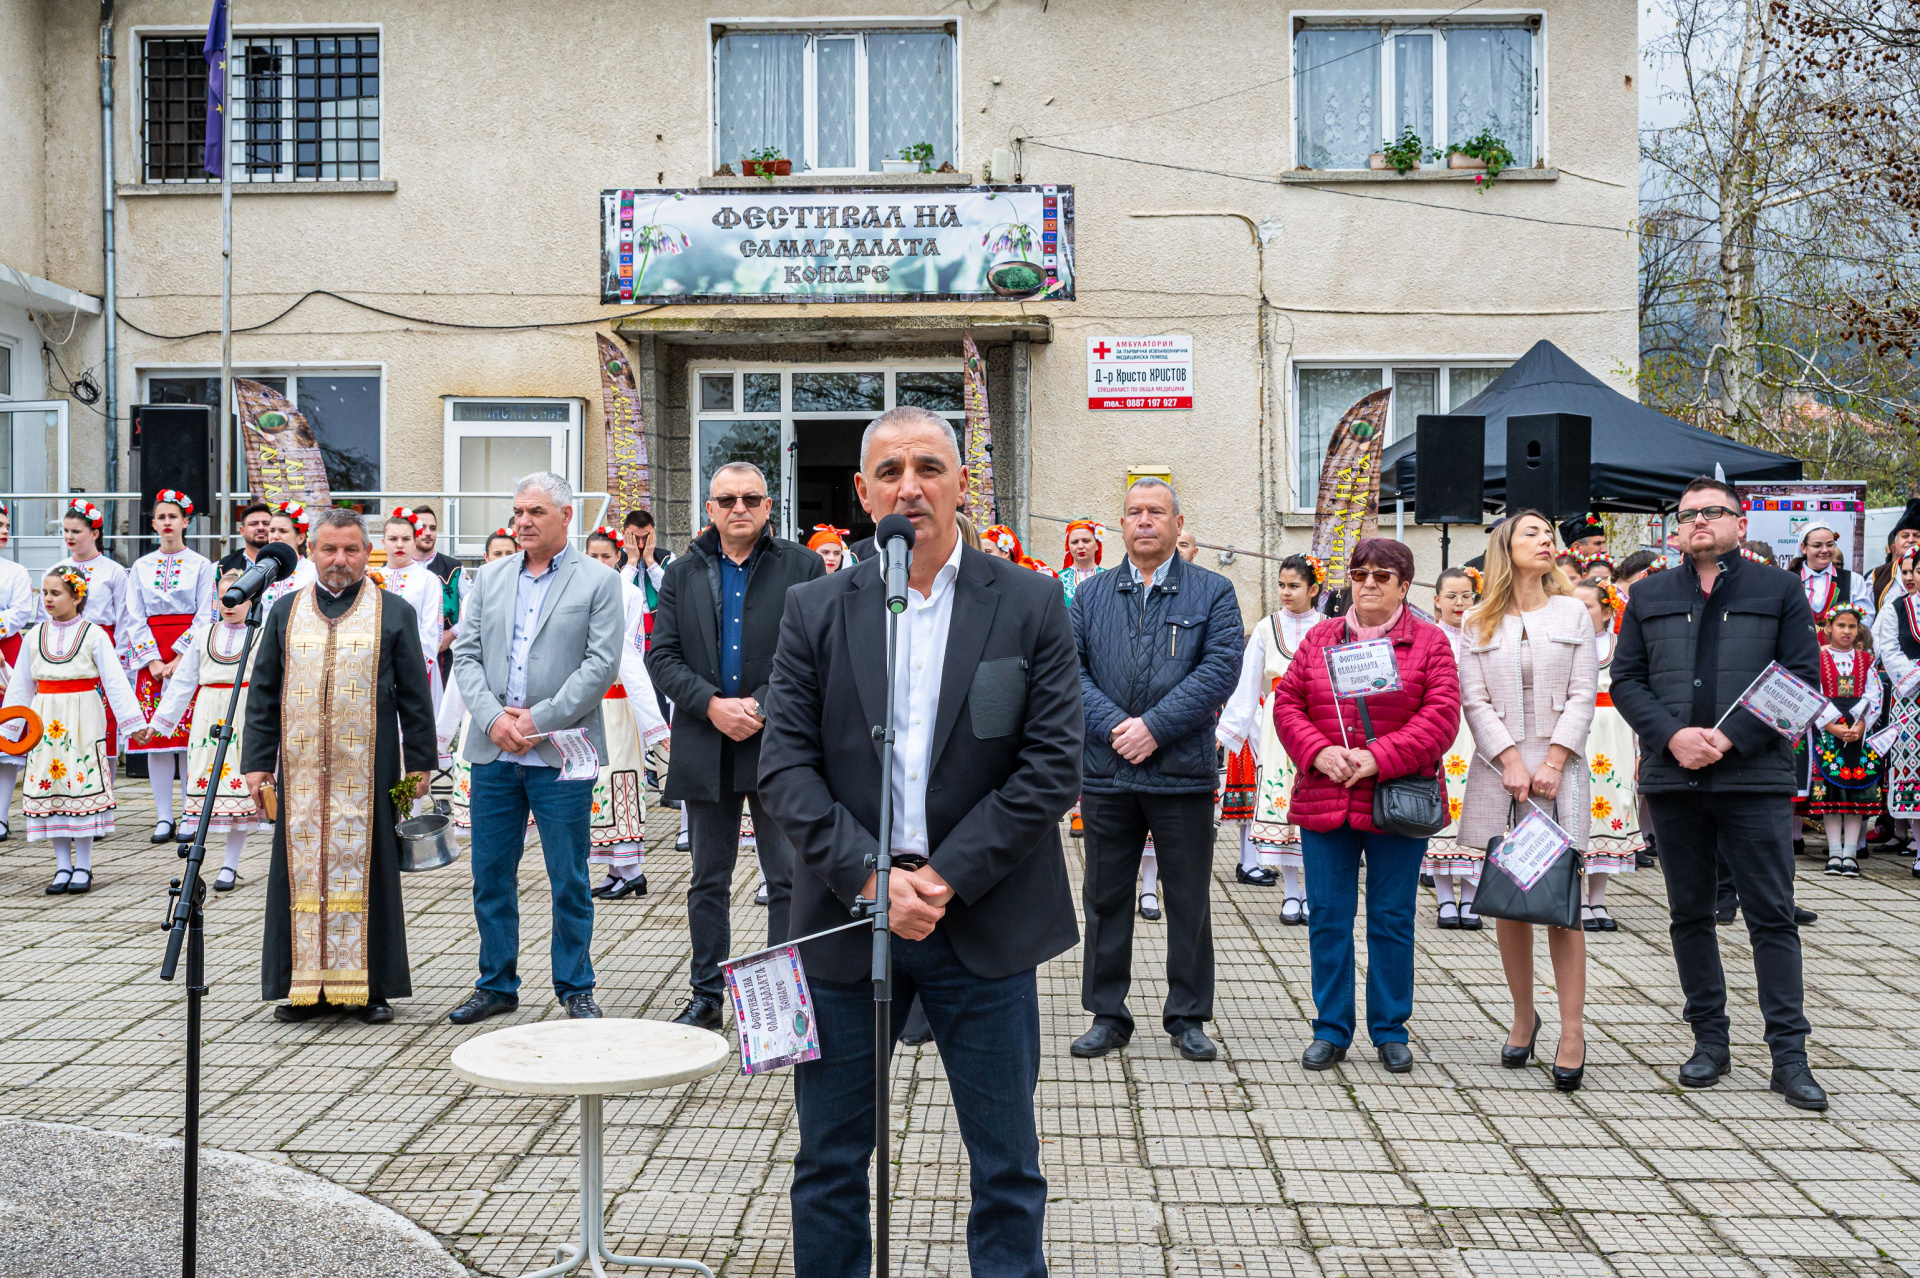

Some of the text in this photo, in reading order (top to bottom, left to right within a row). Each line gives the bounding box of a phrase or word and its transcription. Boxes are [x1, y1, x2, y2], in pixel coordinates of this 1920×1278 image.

[711, 204, 963, 230] ФЕСТИВАЛ НА
[739, 238, 941, 261] САМАРДАЛАТА
[783, 265, 891, 284] КОНАРЕ
[1116, 340, 1174, 348] АМБУЛАТОРИЯ
[1094, 368, 1187, 385] Д-р Христо ХРИСТОВ
[1103, 398, 1178, 408] тел.: 0887 197 927
[1327, 466, 1352, 590] ТИВАЛ НА
[742, 976, 754, 988] НА
[746, 988, 762, 1030] ФЕСТИВАЛ
